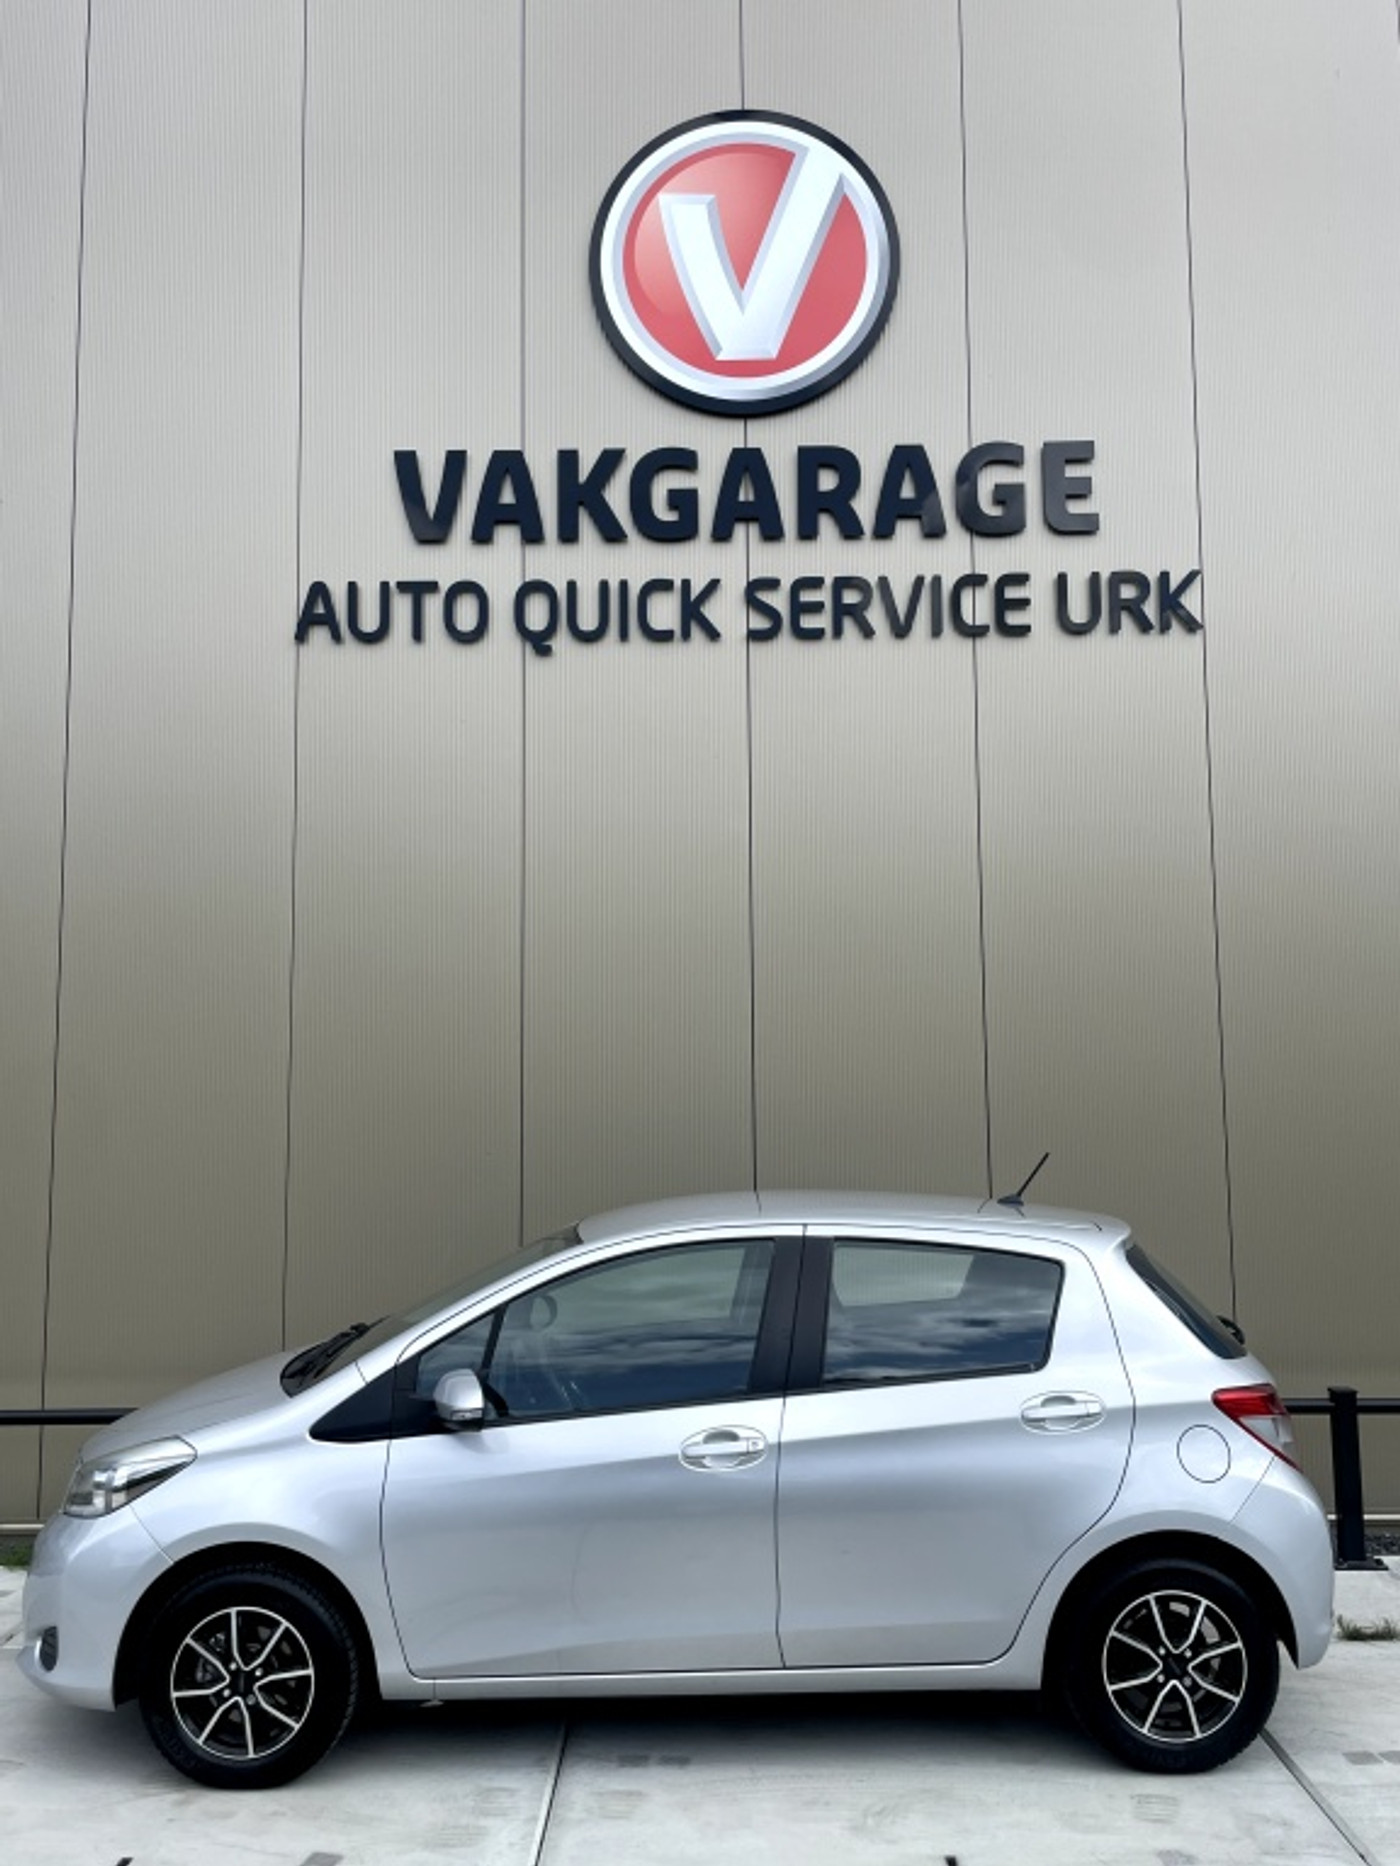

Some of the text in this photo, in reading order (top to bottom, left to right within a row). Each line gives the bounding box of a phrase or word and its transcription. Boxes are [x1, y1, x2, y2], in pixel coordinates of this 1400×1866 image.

[658, 143, 850, 361] V
[394, 441, 1100, 545] VAKGARAGE
[295, 570, 1204, 657] AUTO QUICK SERVICE URK
